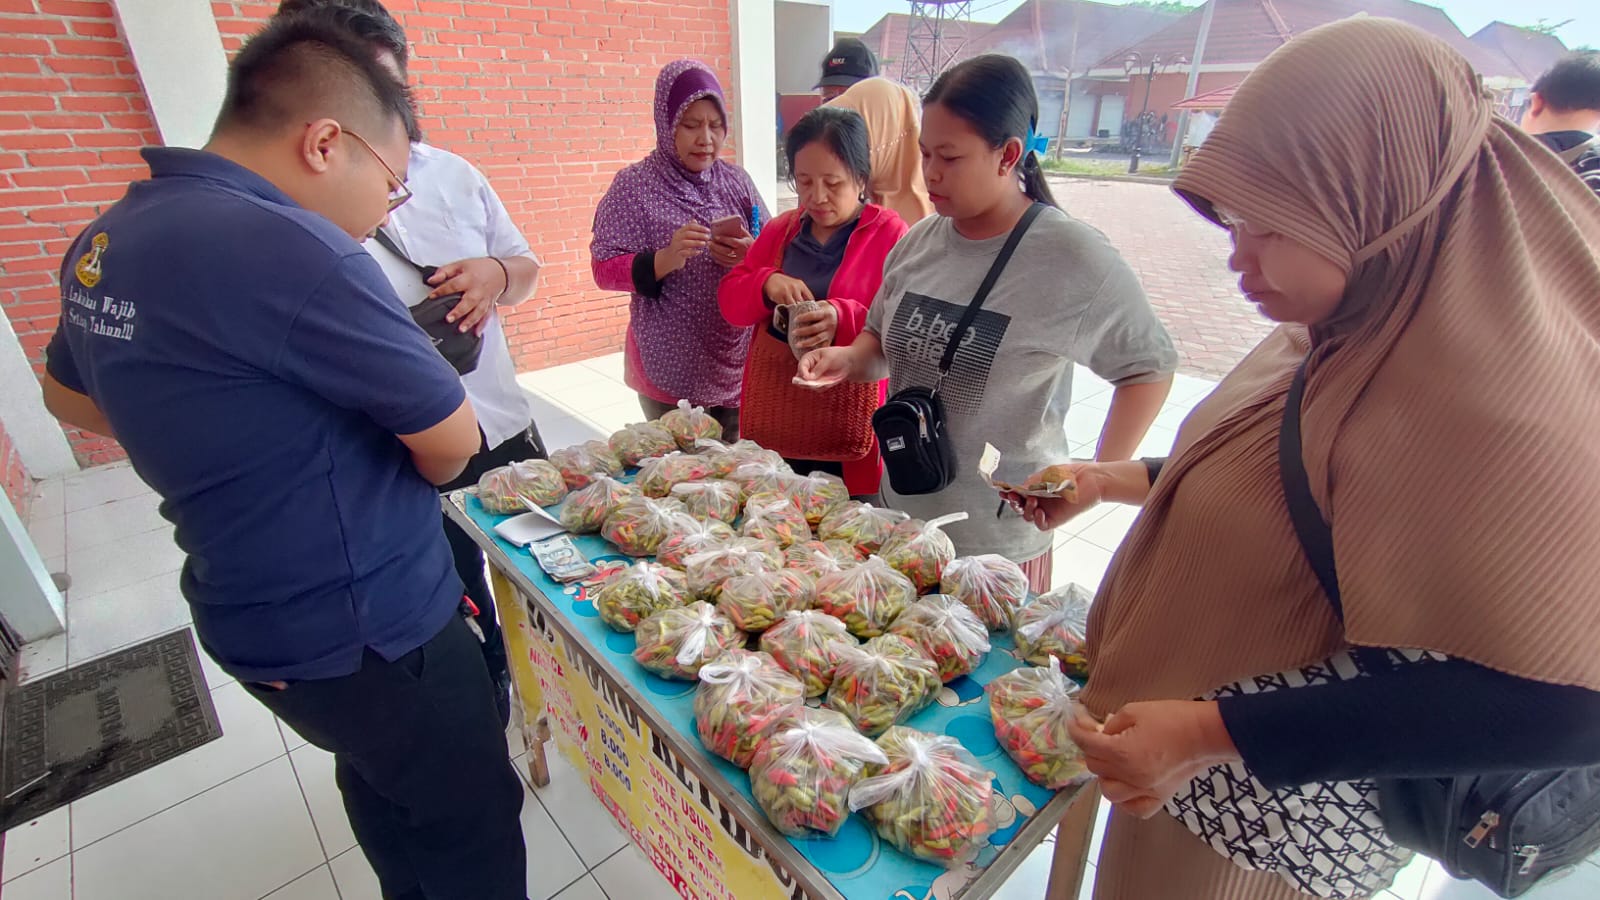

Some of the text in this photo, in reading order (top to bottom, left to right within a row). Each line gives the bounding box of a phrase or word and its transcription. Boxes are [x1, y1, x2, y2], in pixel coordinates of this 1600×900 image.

[102, 296, 136, 321] Wajib
[648, 760, 677, 803] SATE
[681, 797, 713, 842] USUS
[652, 786, 680, 827] SATE
